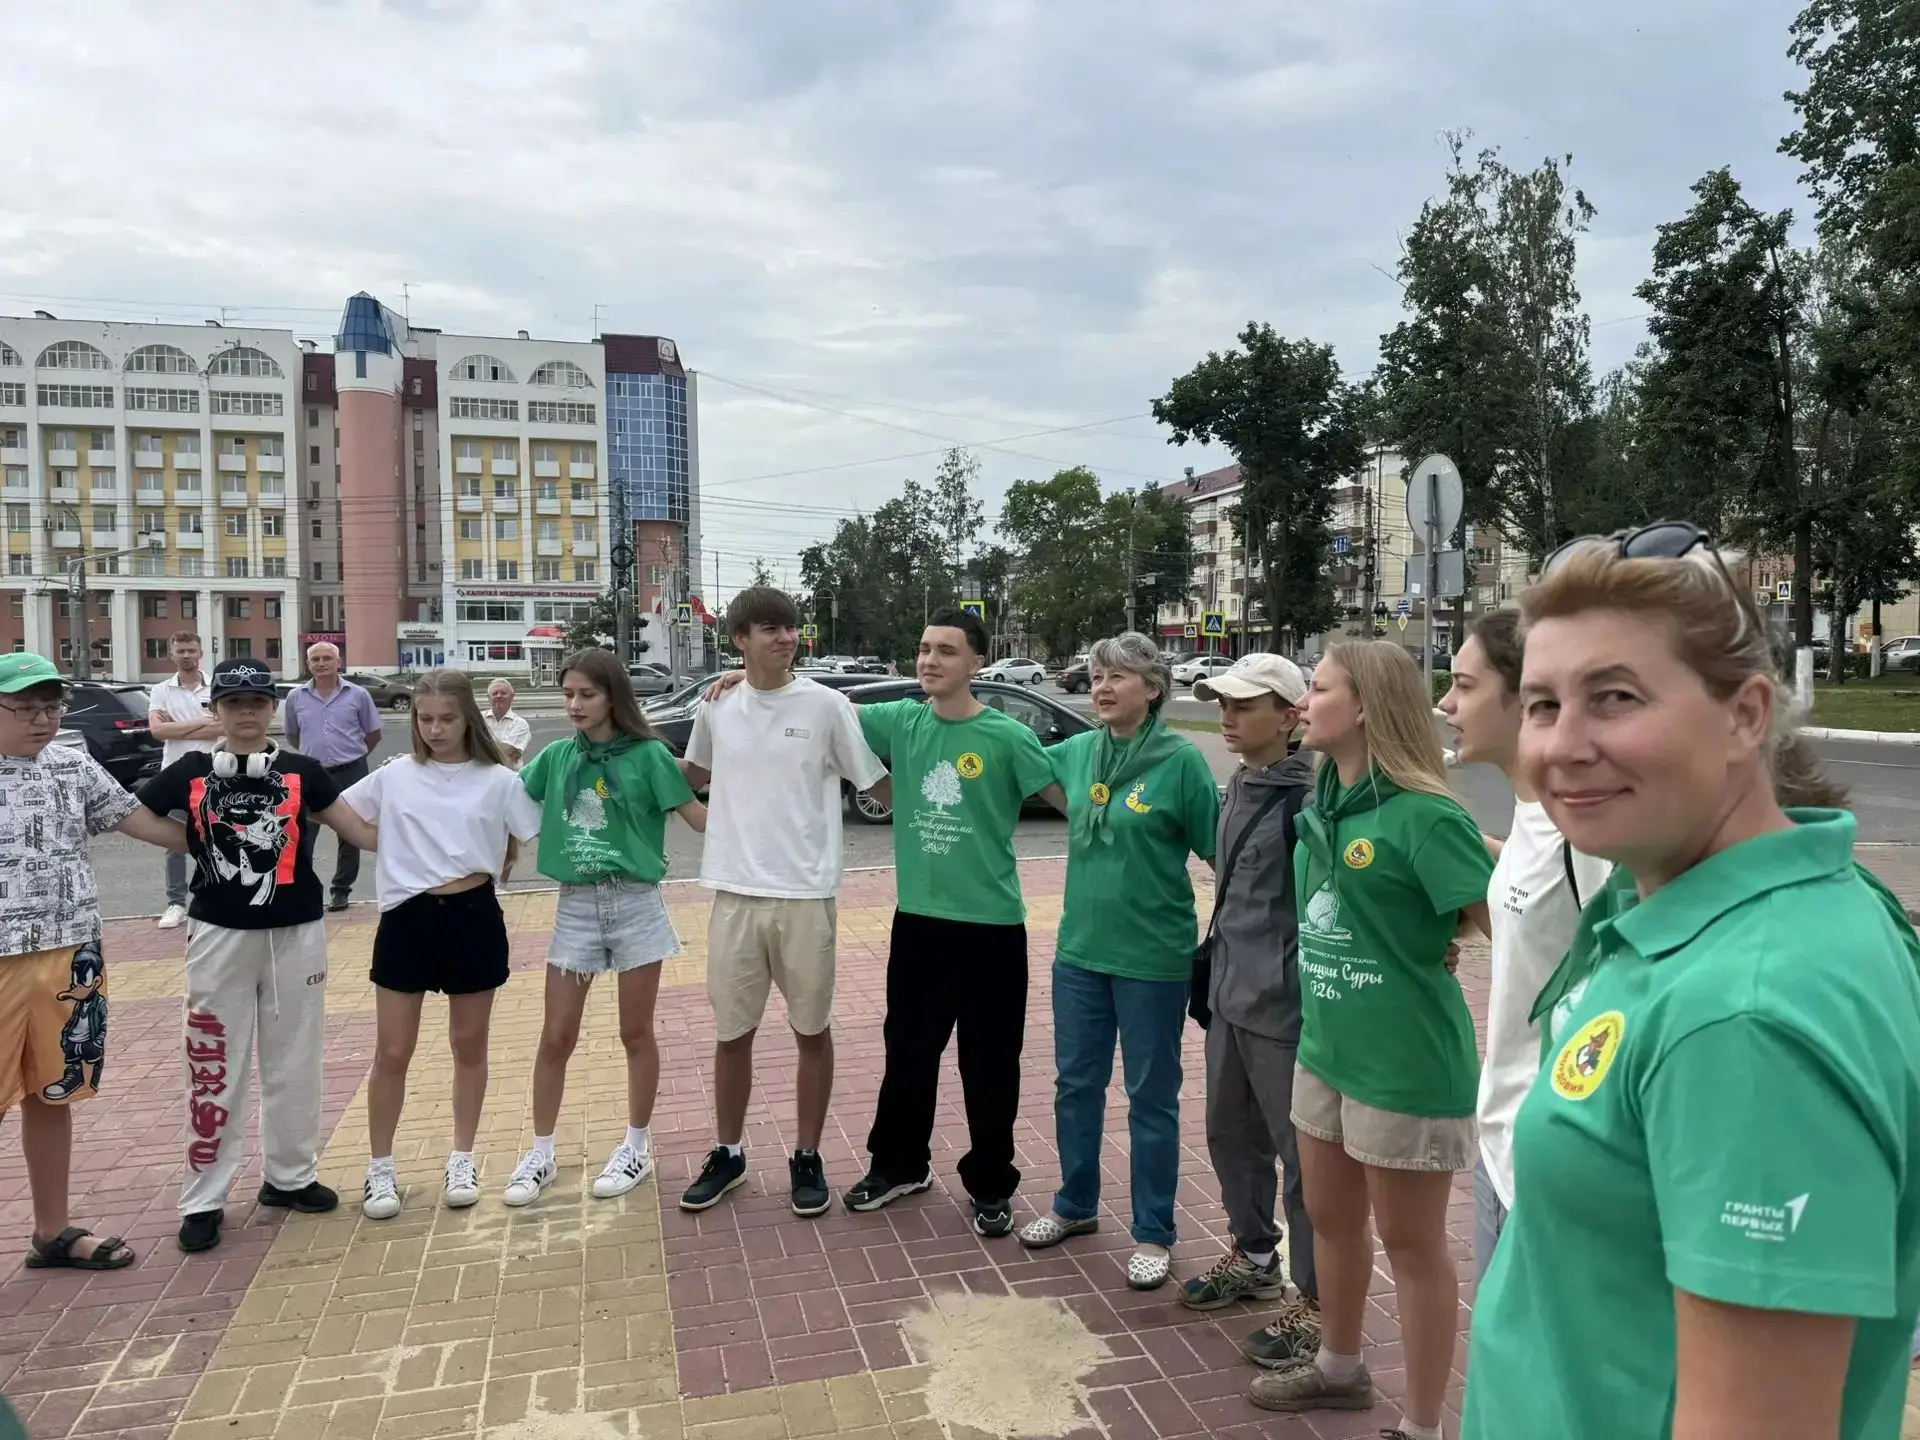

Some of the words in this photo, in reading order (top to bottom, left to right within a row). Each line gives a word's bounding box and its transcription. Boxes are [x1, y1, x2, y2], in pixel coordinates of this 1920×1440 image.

[1342, 963, 1384, 990] Суры
[1725, 1201, 1785, 1219] ГРАНТЫ
[1720, 1213, 1784, 1232] ПЕРВЫХ
